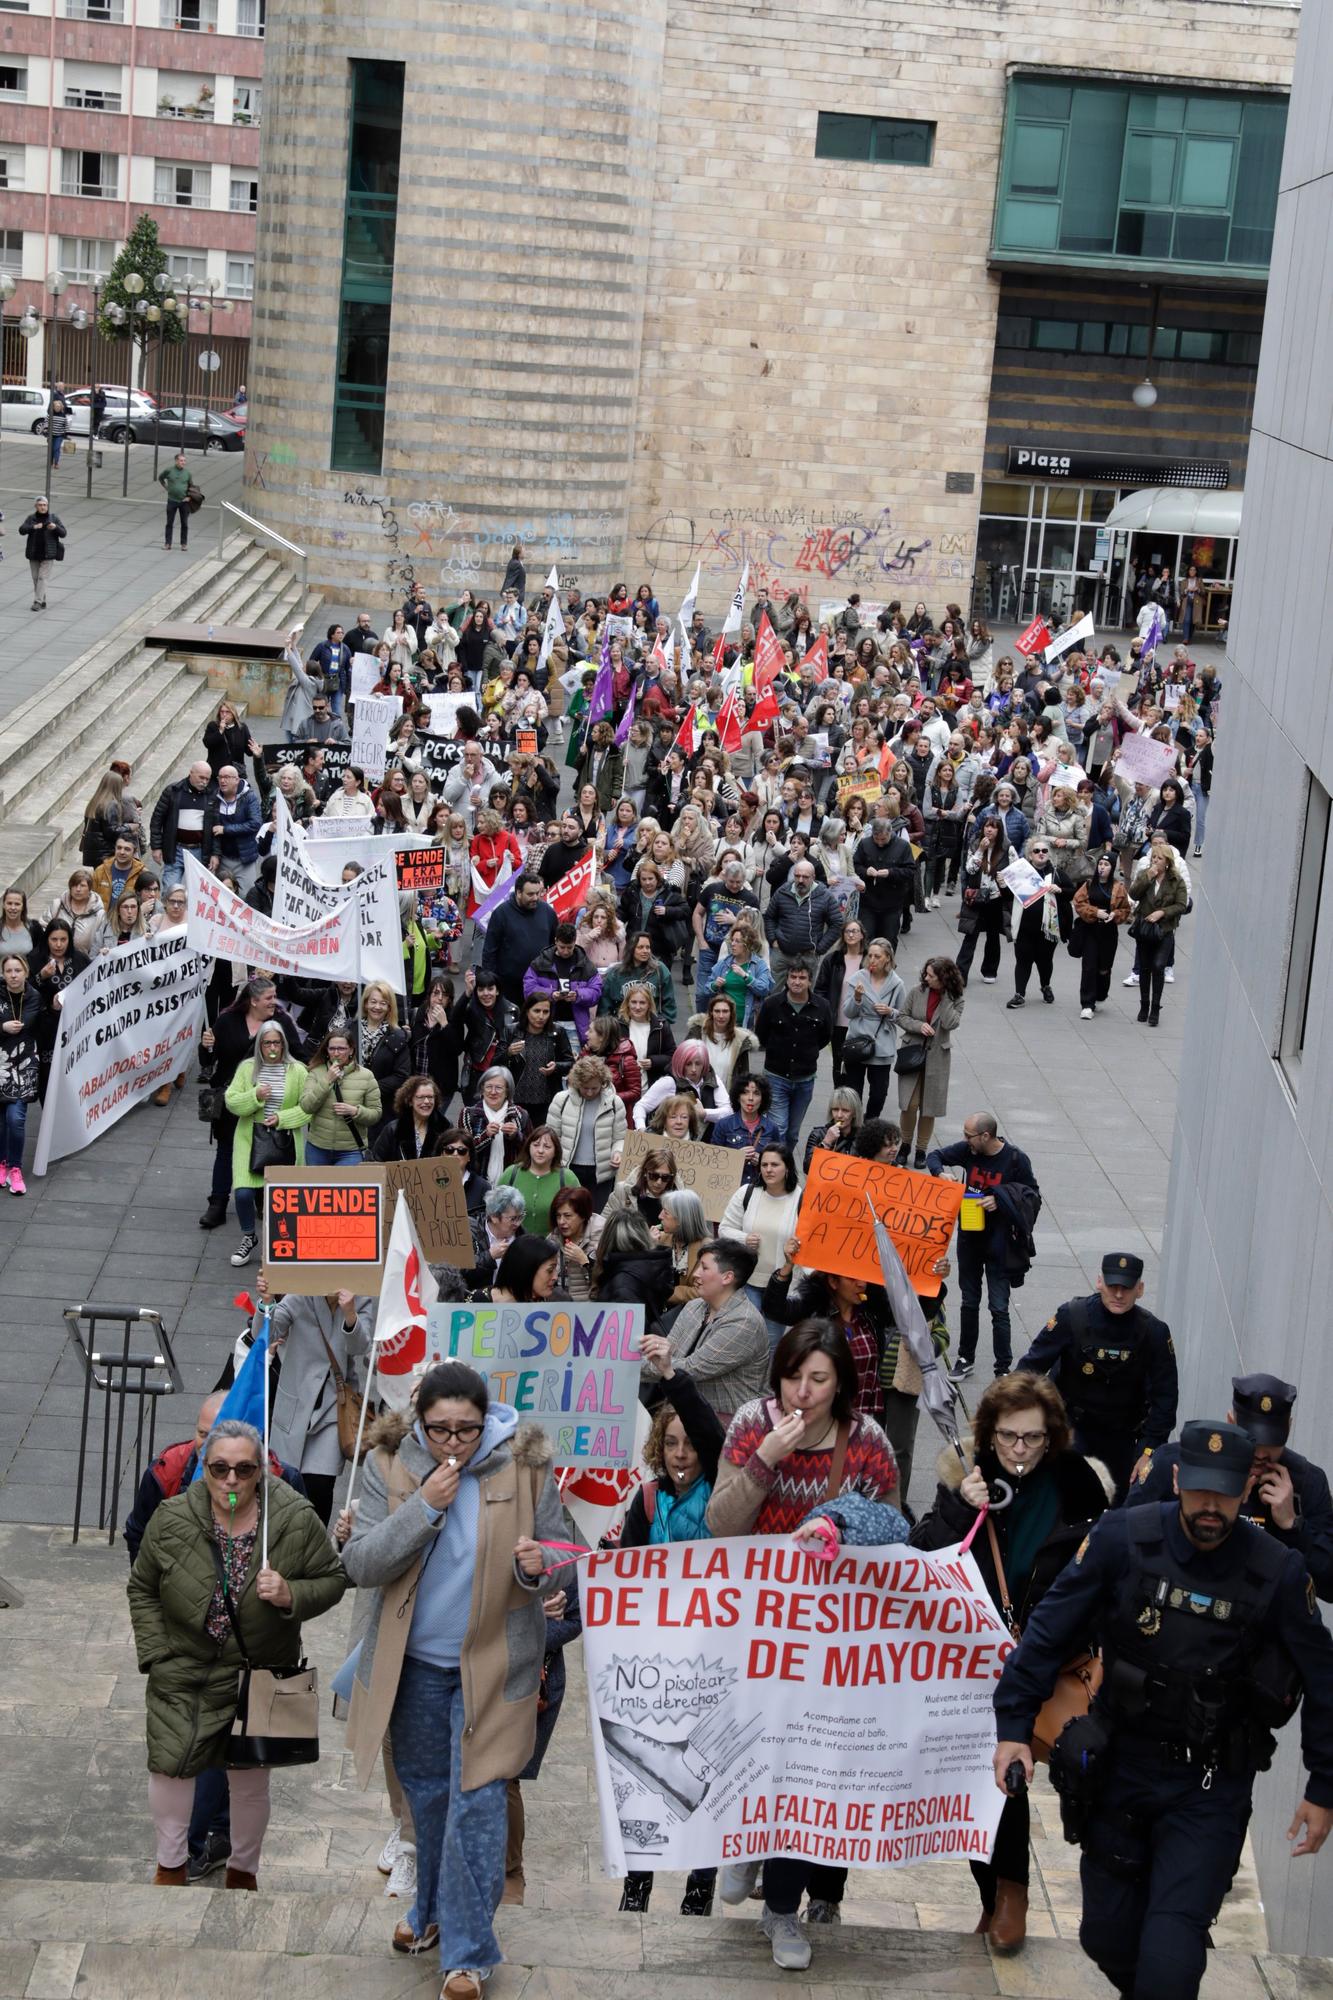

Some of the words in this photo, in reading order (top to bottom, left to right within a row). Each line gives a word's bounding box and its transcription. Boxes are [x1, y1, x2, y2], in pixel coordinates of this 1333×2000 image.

[1018, 450, 1071, 468] Plaza
[1050, 468, 1069, 476] CAFE
[355, 701, 390, 724] DERECHO
[363, 727, 372, 738] A
[353, 742, 384, 765] ELEGIR
[409, 849, 443, 865] VENDE
[402, 878, 412, 889] LA
[413, 875, 442, 888] GERENTE
[413, 866, 437, 878] ERA
[150, 968, 177, 990] SIN
[76, 1034, 91, 1063] HAY
[95, 1008, 141, 1046] CALIDAD
[153, 1039, 171, 1060] DEL
[85, 1102, 101, 1130] CPR
[102, 1082, 129, 1118] CLARA
[818, 1156, 957, 1215] GERENTE
[272, 1188, 299, 1213] SE
[303, 1188, 376, 1213] VENDE
[429, 1192, 438, 1220] Y
[445, 1192, 466, 1218] EL
[810, 1190, 842, 1214] NO
[808, 1222, 829, 1244] A
[836, 1226, 869, 1260] TU
[448, 1309, 642, 1361] PERSONAL
[558, 1426, 627, 1457] REAL
[587, 1548, 669, 1579] POR
[681, 1547, 730, 1579] LA
[586, 1587, 643, 1627] DE
[657, 1587, 742, 1628] LAS
[755, 1589, 1000, 1634] RESIDENCIAS
[747, 1639, 810, 1682] DE
[823, 1641, 1017, 1687] MAYORES
[616, 1664, 660, 1691] NO
[665, 1672, 726, 1701] pisotear
[620, 1694, 648, 1709] mis
[652, 1690, 720, 1710] derechos
[960, 1692, 972, 1701] del
[863, 1716, 877, 1724] con
[941, 1706, 961, 1716] duele
[962, 1705, 969, 1714] el
[786, 1722, 804, 1731] más
[807, 1724, 856, 1738] frecuencia
[857, 1728, 865, 1737] al
[761, 1736, 786, 1745] estoy
[787, 1737, 808, 1745] arta
[810, 1738, 822, 1747] de
[824, 1740, 875, 1751] infecciones
[876, 1742, 887, 1751] de
[888, 1741, 908, 1750] orina
[734, 1767, 748, 1781] que
[747, 1757, 755, 1767] el
[785, 1761, 819, 1774] Lávame
[821, 1769, 838, 1777] con
[839, 1769, 857, 1778] más
[860, 1768, 904, 1778] frecuencia
[712, 1794, 737, 1822] silencio
[737, 1782, 749, 1794] me
[749, 1764, 770, 1782] duele
[772, 1775, 784, 1784] las
[785, 1776, 814, 1786] manos
[816, 1780, 836, 1790] para
[838, 1782, 865, 1791] evitar
[868, 1781, 913, 1792] infecciones
[742, 1796, 767, 1825] LA
[774, 1794, 838, 1830] FALTA
[845, 1803, 876, 1832] DE
[881, 1793, 975, 1832] PERSONAL
[722, 1833, 742, 1859] ES
[746, 1830, 770, 1855] UN
[773, 1828, 871, 1862] MALTRATO
[876, 1828, 989, 1863] INSTITUCIONAL
